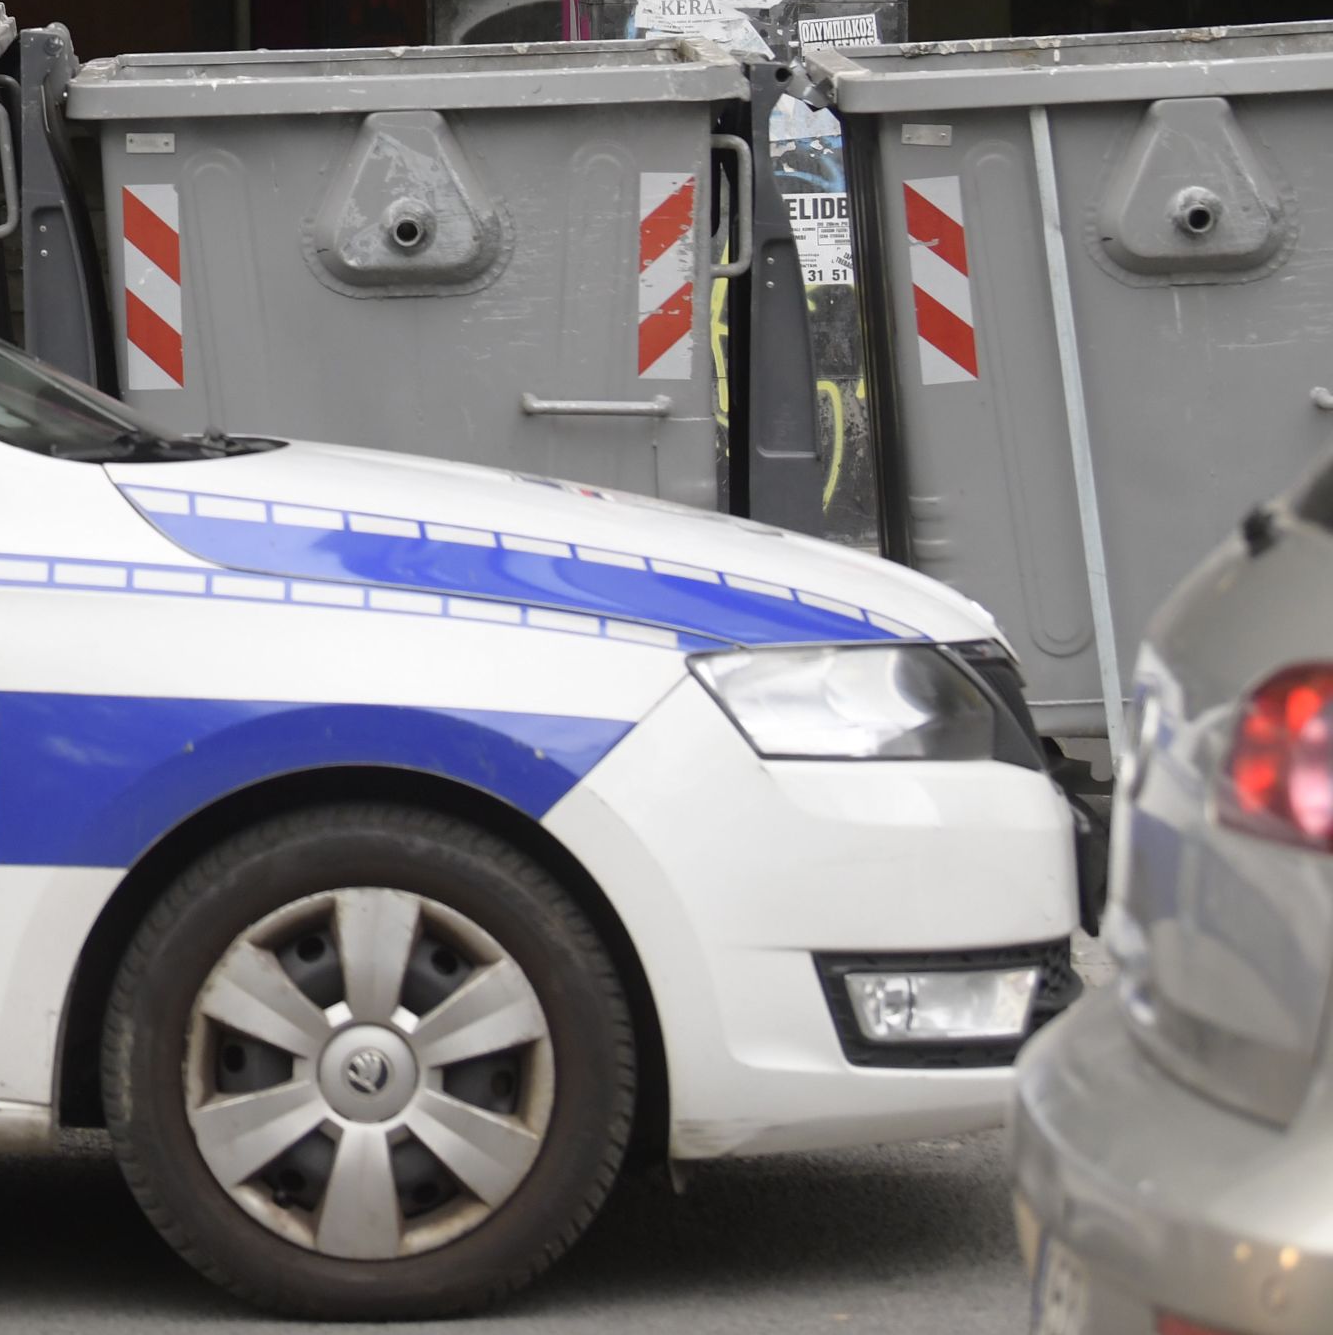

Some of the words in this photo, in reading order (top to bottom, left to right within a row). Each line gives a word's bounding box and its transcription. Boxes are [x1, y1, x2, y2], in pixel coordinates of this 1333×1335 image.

[801, 16, 875, 43] ΟΛΥΜΠΙΑΚΟΣ
[808, 269, 823, 282] 31
[832, 269, 848, 281] 51
